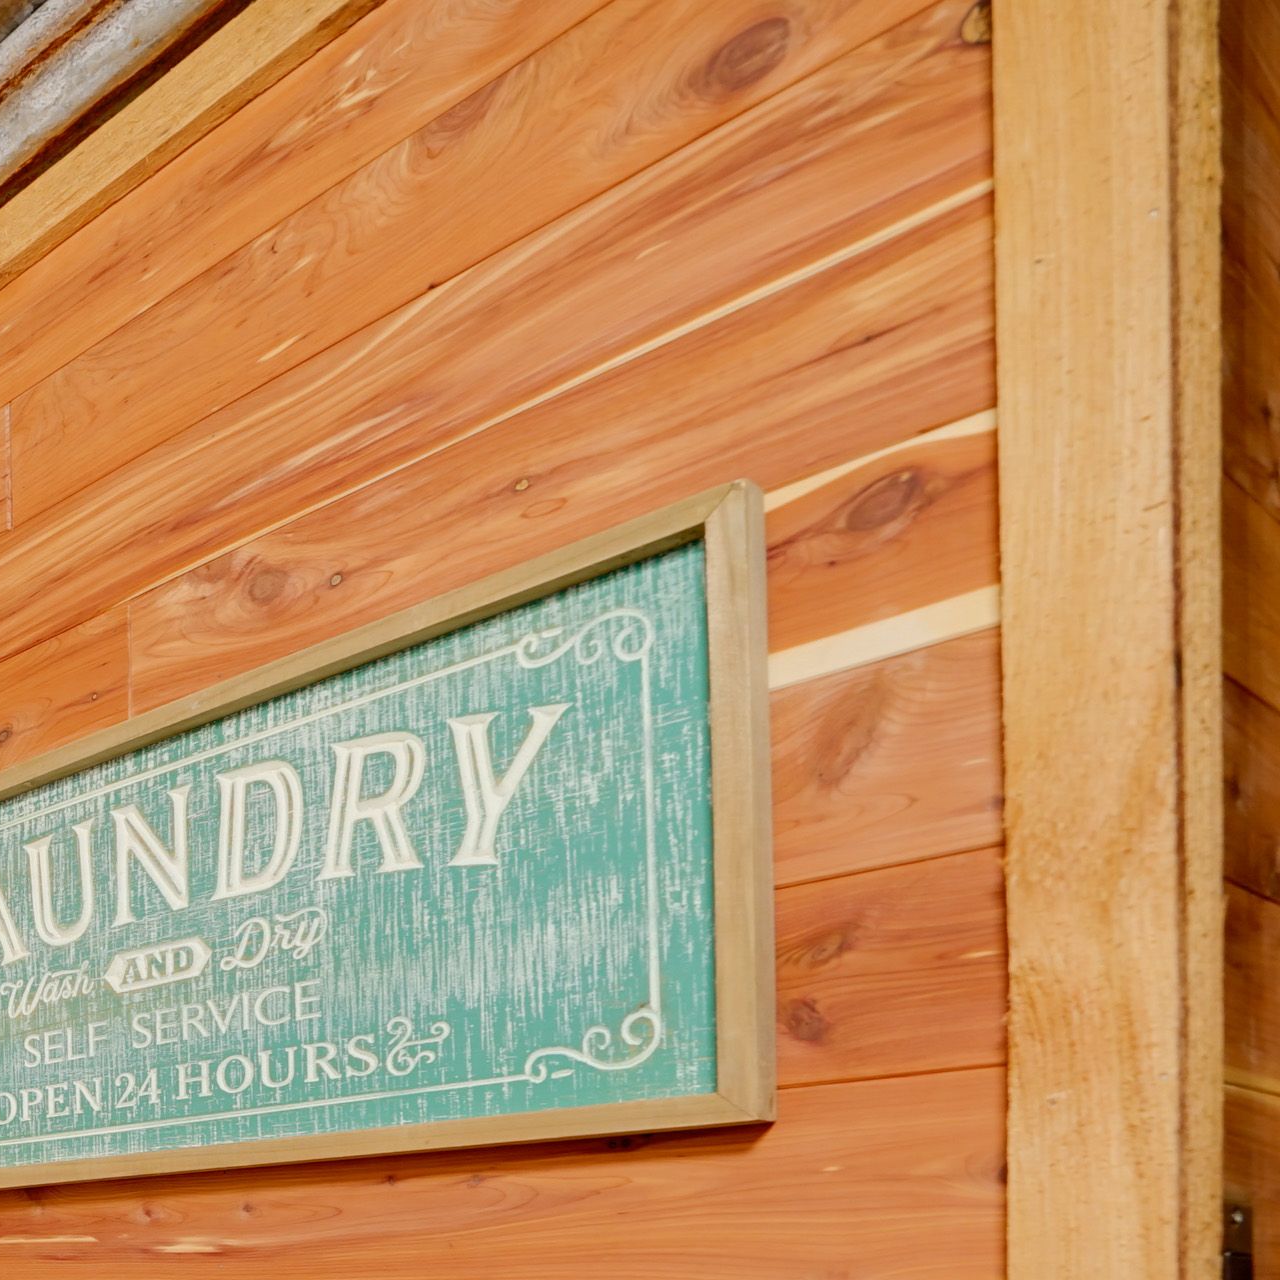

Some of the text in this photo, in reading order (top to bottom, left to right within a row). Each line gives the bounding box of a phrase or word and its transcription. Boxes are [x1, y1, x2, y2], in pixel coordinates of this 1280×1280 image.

[0, 907, 329, 1020] Wash AND Dry
[24, 981, 323, 1069] SELF SERVICE
[114, 1071, 160, 1109] 24
[177, 1036, 378, 1100] HOURS
